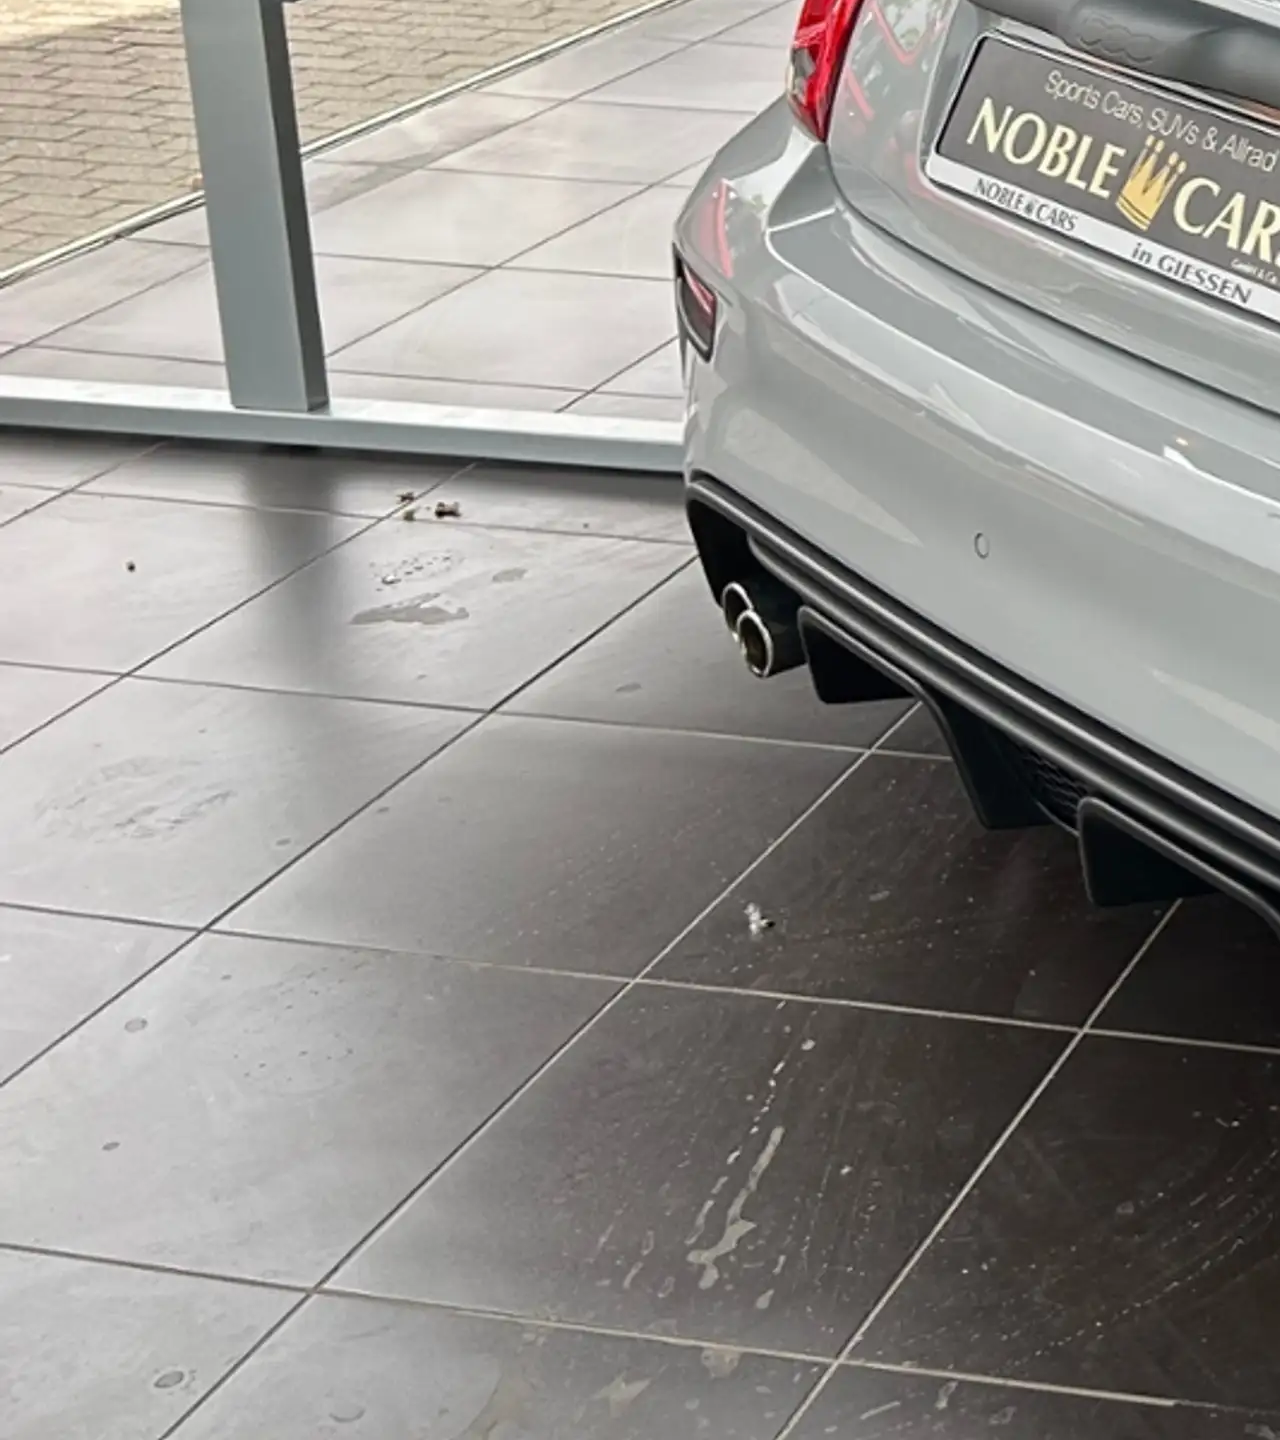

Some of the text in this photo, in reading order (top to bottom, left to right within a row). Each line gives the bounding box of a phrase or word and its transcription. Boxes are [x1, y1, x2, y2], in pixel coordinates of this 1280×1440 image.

[966, 95, 1127, 200] NOBLE
[1044, 69, 1280, 173] Sports Cars, SUVs & Allrad
[975, 177, 1252, 304] NOBLE CARS in GIESSEN
